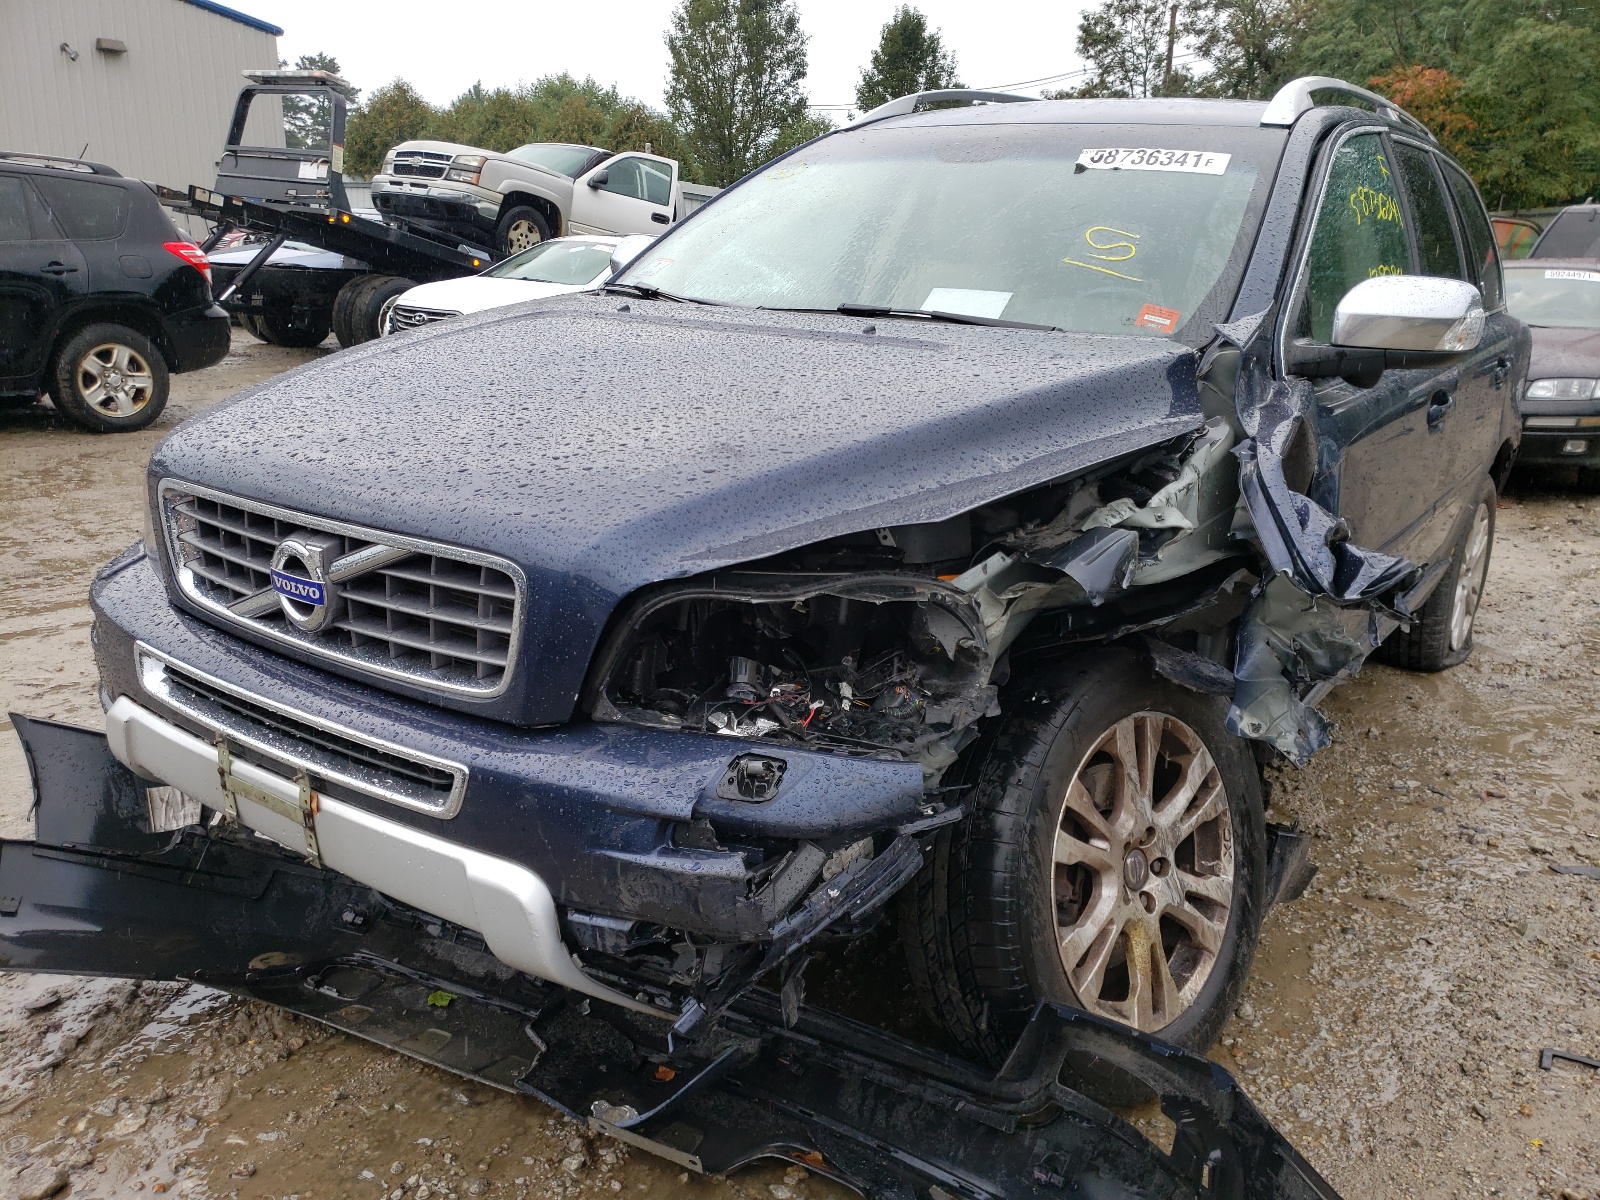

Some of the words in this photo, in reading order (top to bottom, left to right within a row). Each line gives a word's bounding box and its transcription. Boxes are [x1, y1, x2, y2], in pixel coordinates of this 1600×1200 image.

[1089, 149, 1204, 168] 58736341
[1204, 158, 1216, 167] F
[273, 576, 320, 599] VOLVO
